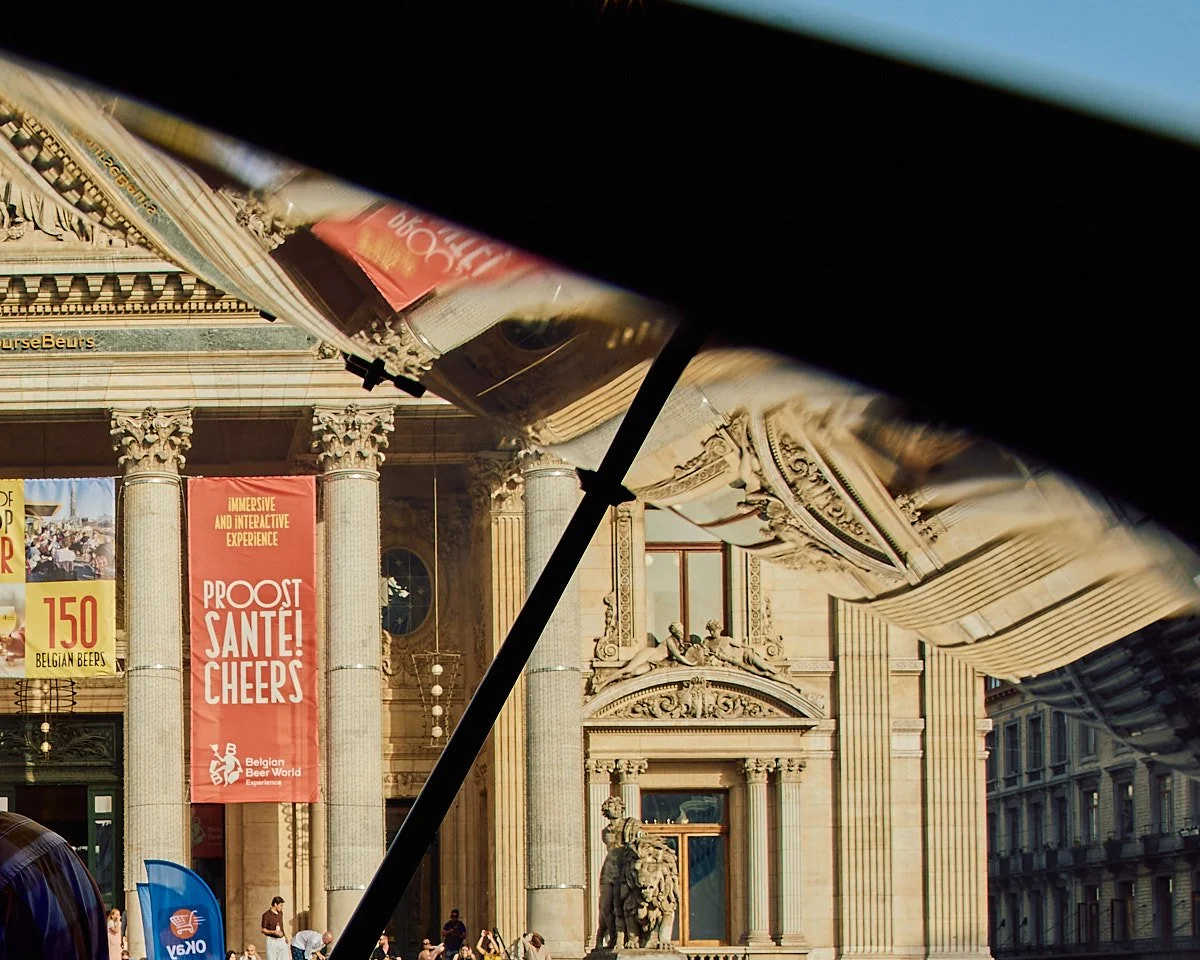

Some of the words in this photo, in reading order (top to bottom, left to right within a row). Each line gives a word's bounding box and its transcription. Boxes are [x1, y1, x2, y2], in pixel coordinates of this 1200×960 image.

[214, 514, 232, 530] AND
[203, 578, 303, 610] PROOST
[43, 595, 98, 649] 150
[204, 606, 303, 658] SANTÉ!
[36, 652, 74, 668] BELGIAN
[77, 651, 106, 667] BEERS
[204, 659, 304, 705] CHEERS
[245, 757, 285, 768] Belgian
[245, 767, 270, 778] Beer
[271, 767, 302, 778] World
[245, 778, 282, 787] Experience
